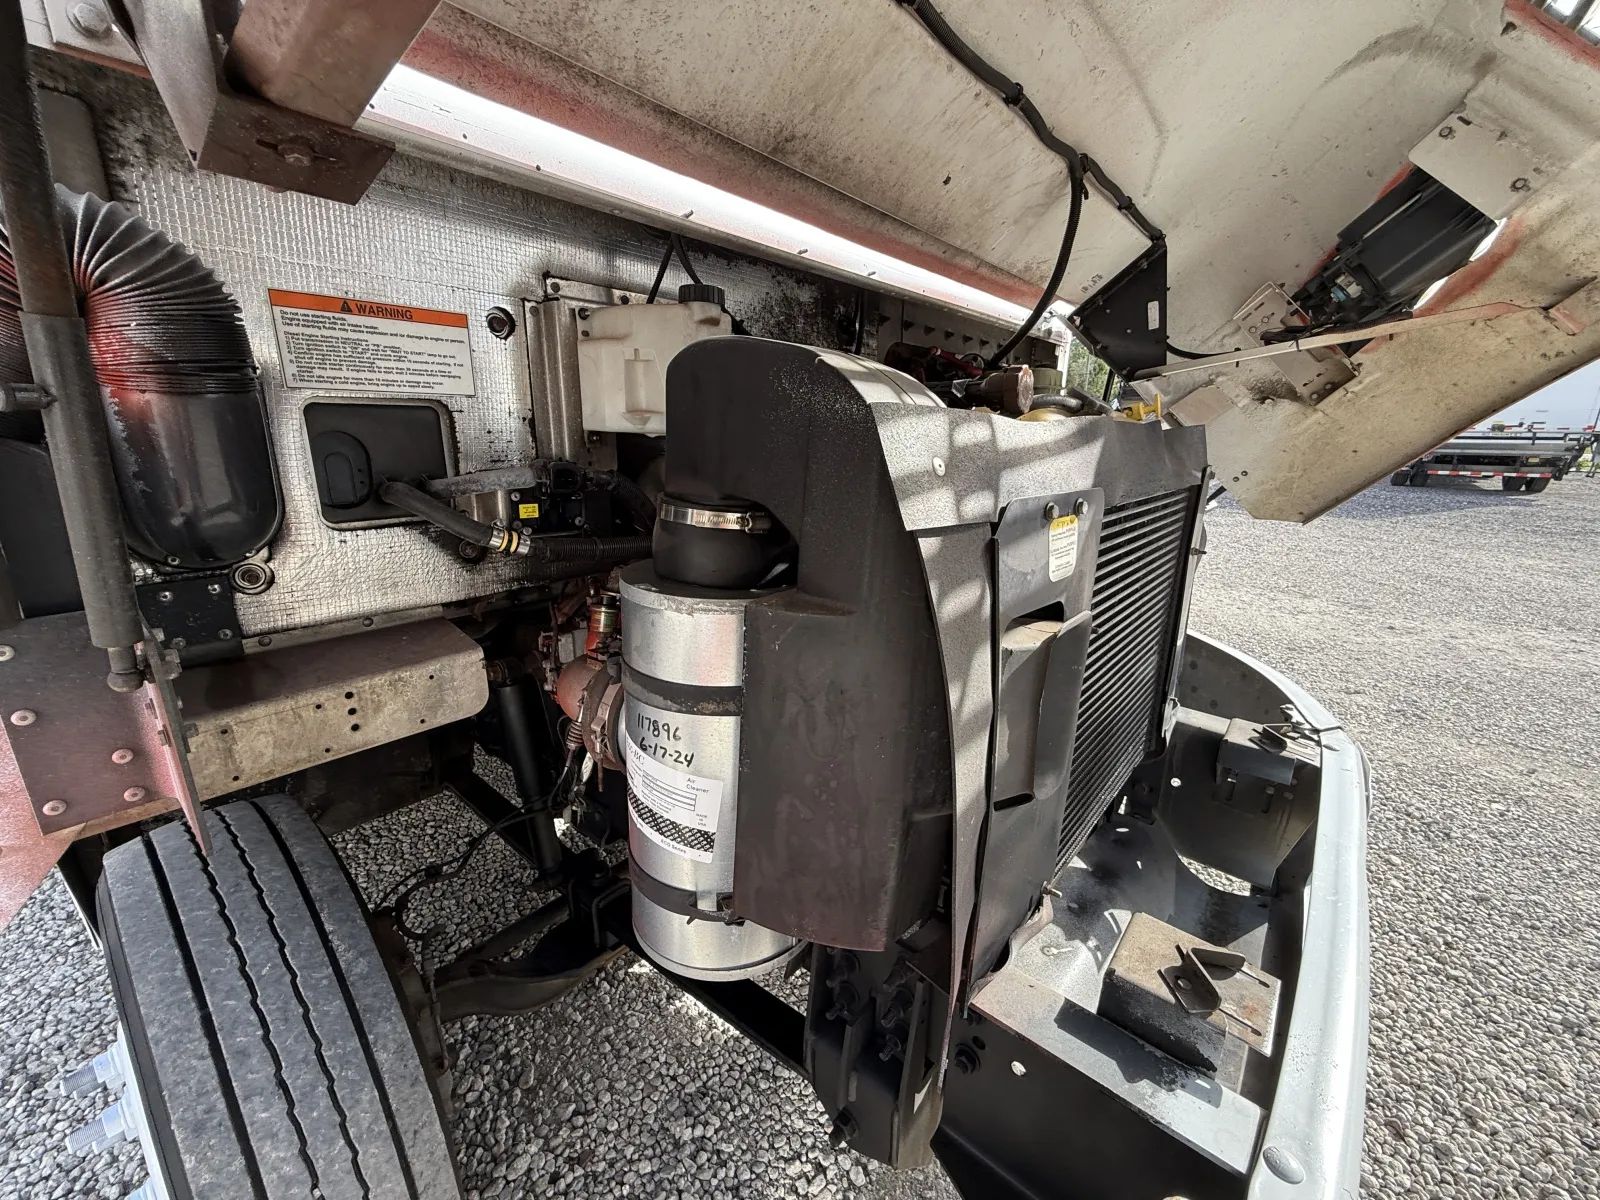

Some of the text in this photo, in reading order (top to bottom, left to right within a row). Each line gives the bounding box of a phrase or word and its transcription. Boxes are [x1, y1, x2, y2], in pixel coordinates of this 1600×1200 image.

[356, 304, 413, 320] WARNING
[638, 713, 682, 742] 117896
[640, 737, 694, 768] 6-17-24
[686, 784, 710, 794] Cleaner
